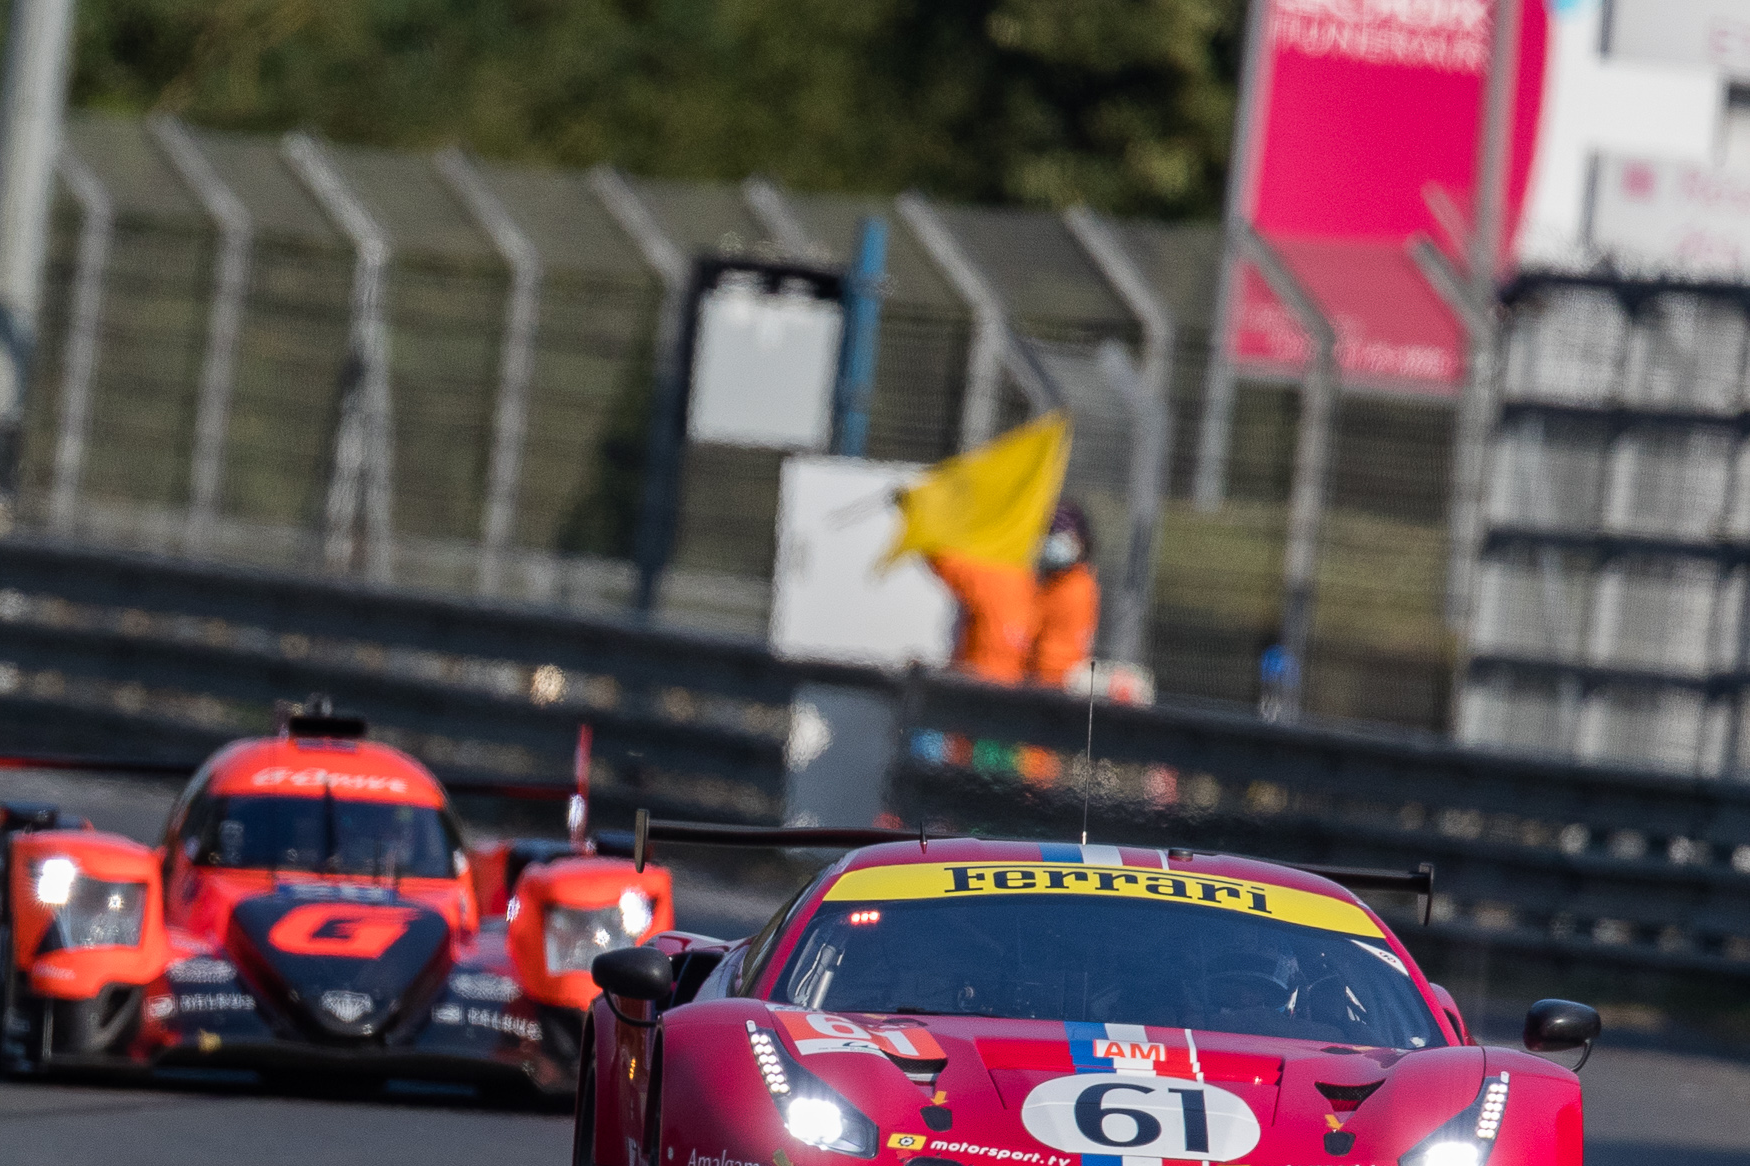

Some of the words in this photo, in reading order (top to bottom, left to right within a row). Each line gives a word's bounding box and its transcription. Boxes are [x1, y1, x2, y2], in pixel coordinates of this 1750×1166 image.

[944, 865, 1272, 914] Ferrari
[806, 1013, 920, 1057] 61
[1103, 1041, 1161, 1060] AM
[1073, 1082, 1209, 1153] 61
